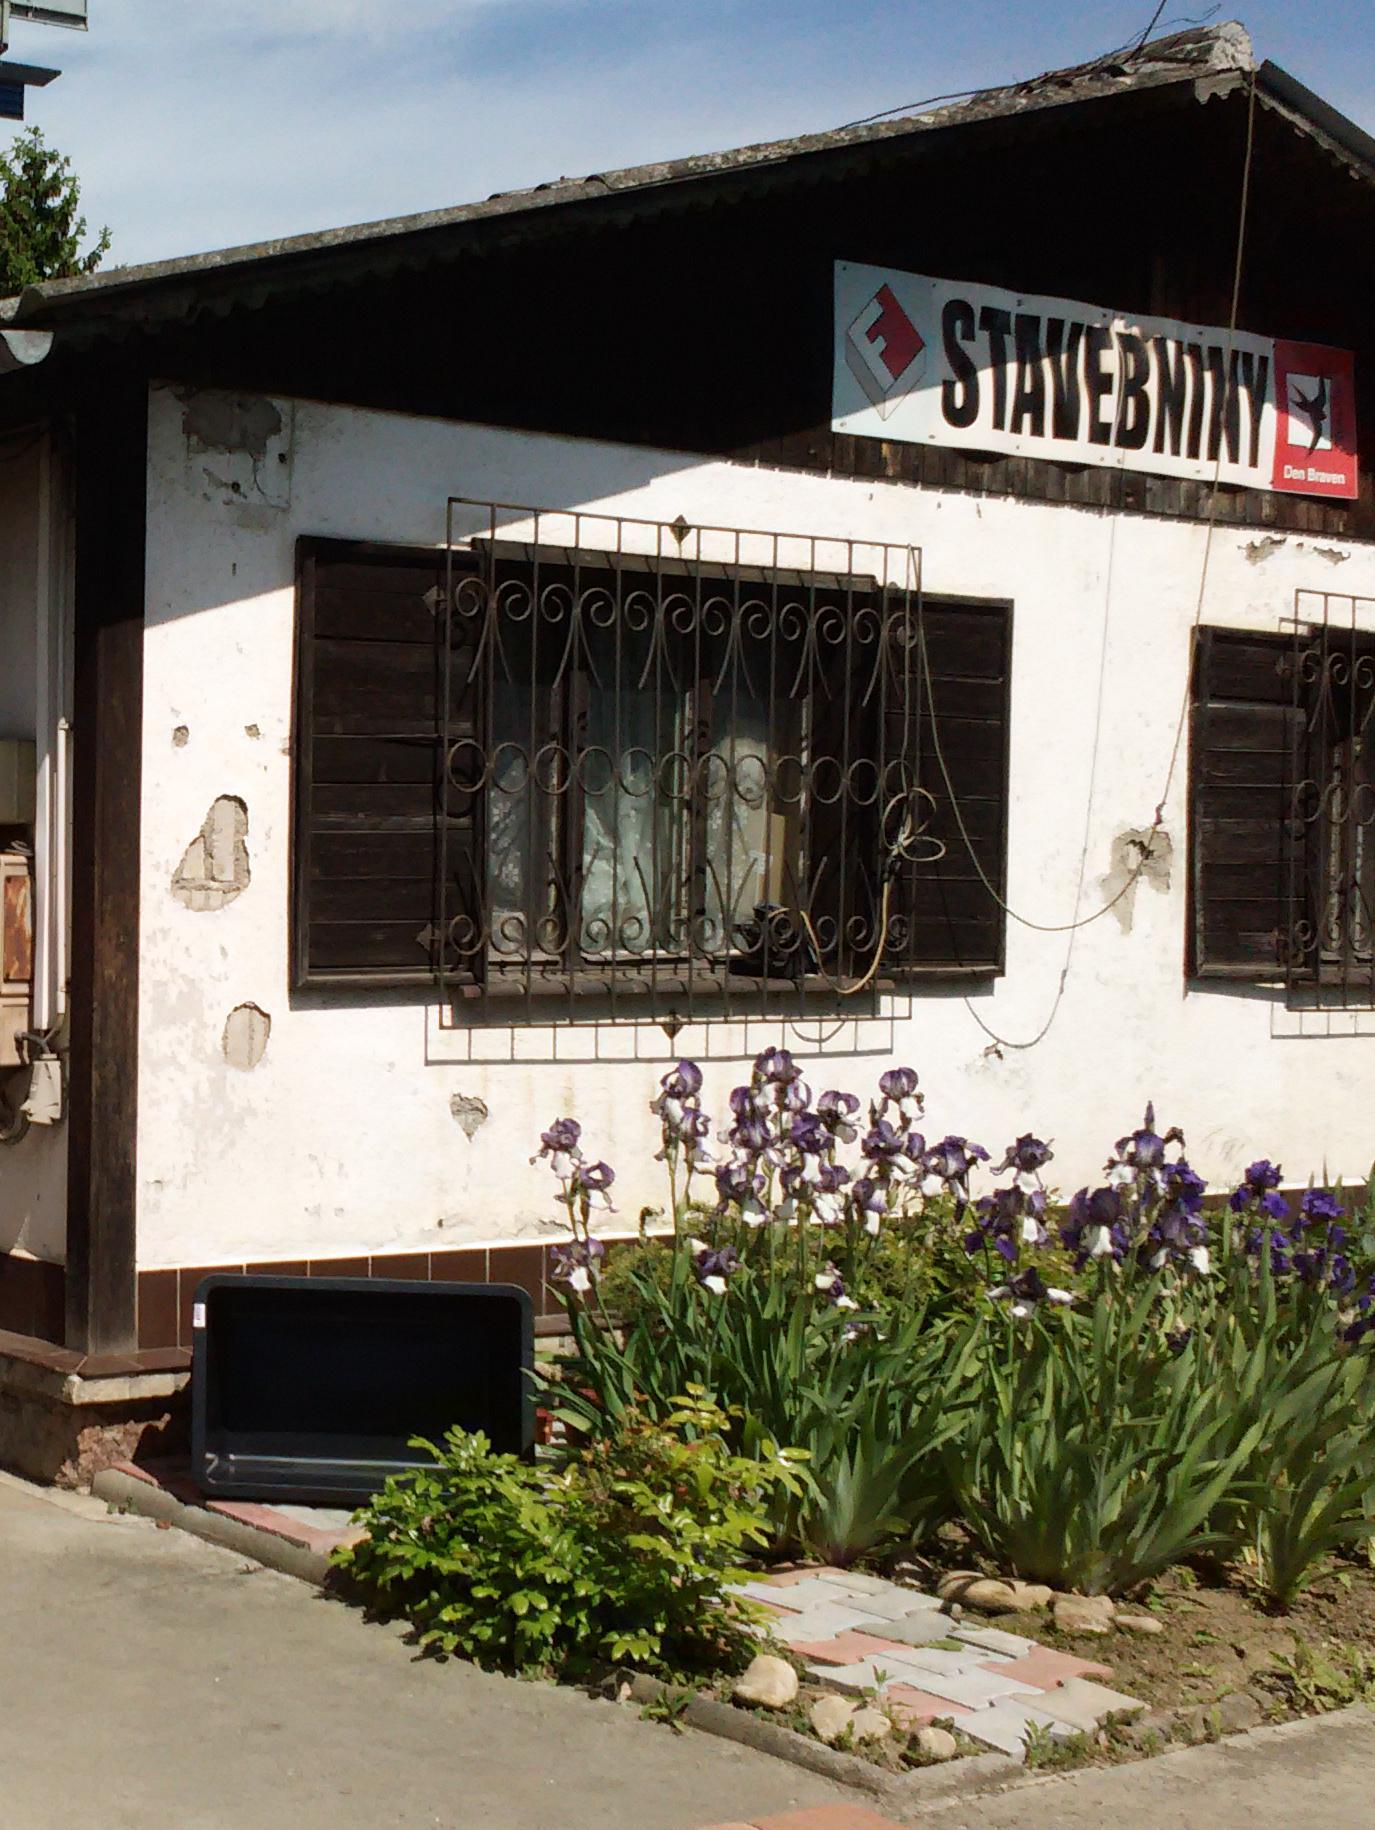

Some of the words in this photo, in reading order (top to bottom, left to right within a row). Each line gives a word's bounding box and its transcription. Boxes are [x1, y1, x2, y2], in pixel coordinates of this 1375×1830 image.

[940, 299, 1270, 469] STAVEBNINY
[1283, 464, 1306, 480] Den
[1307, 468, 1346, 485] Braven
